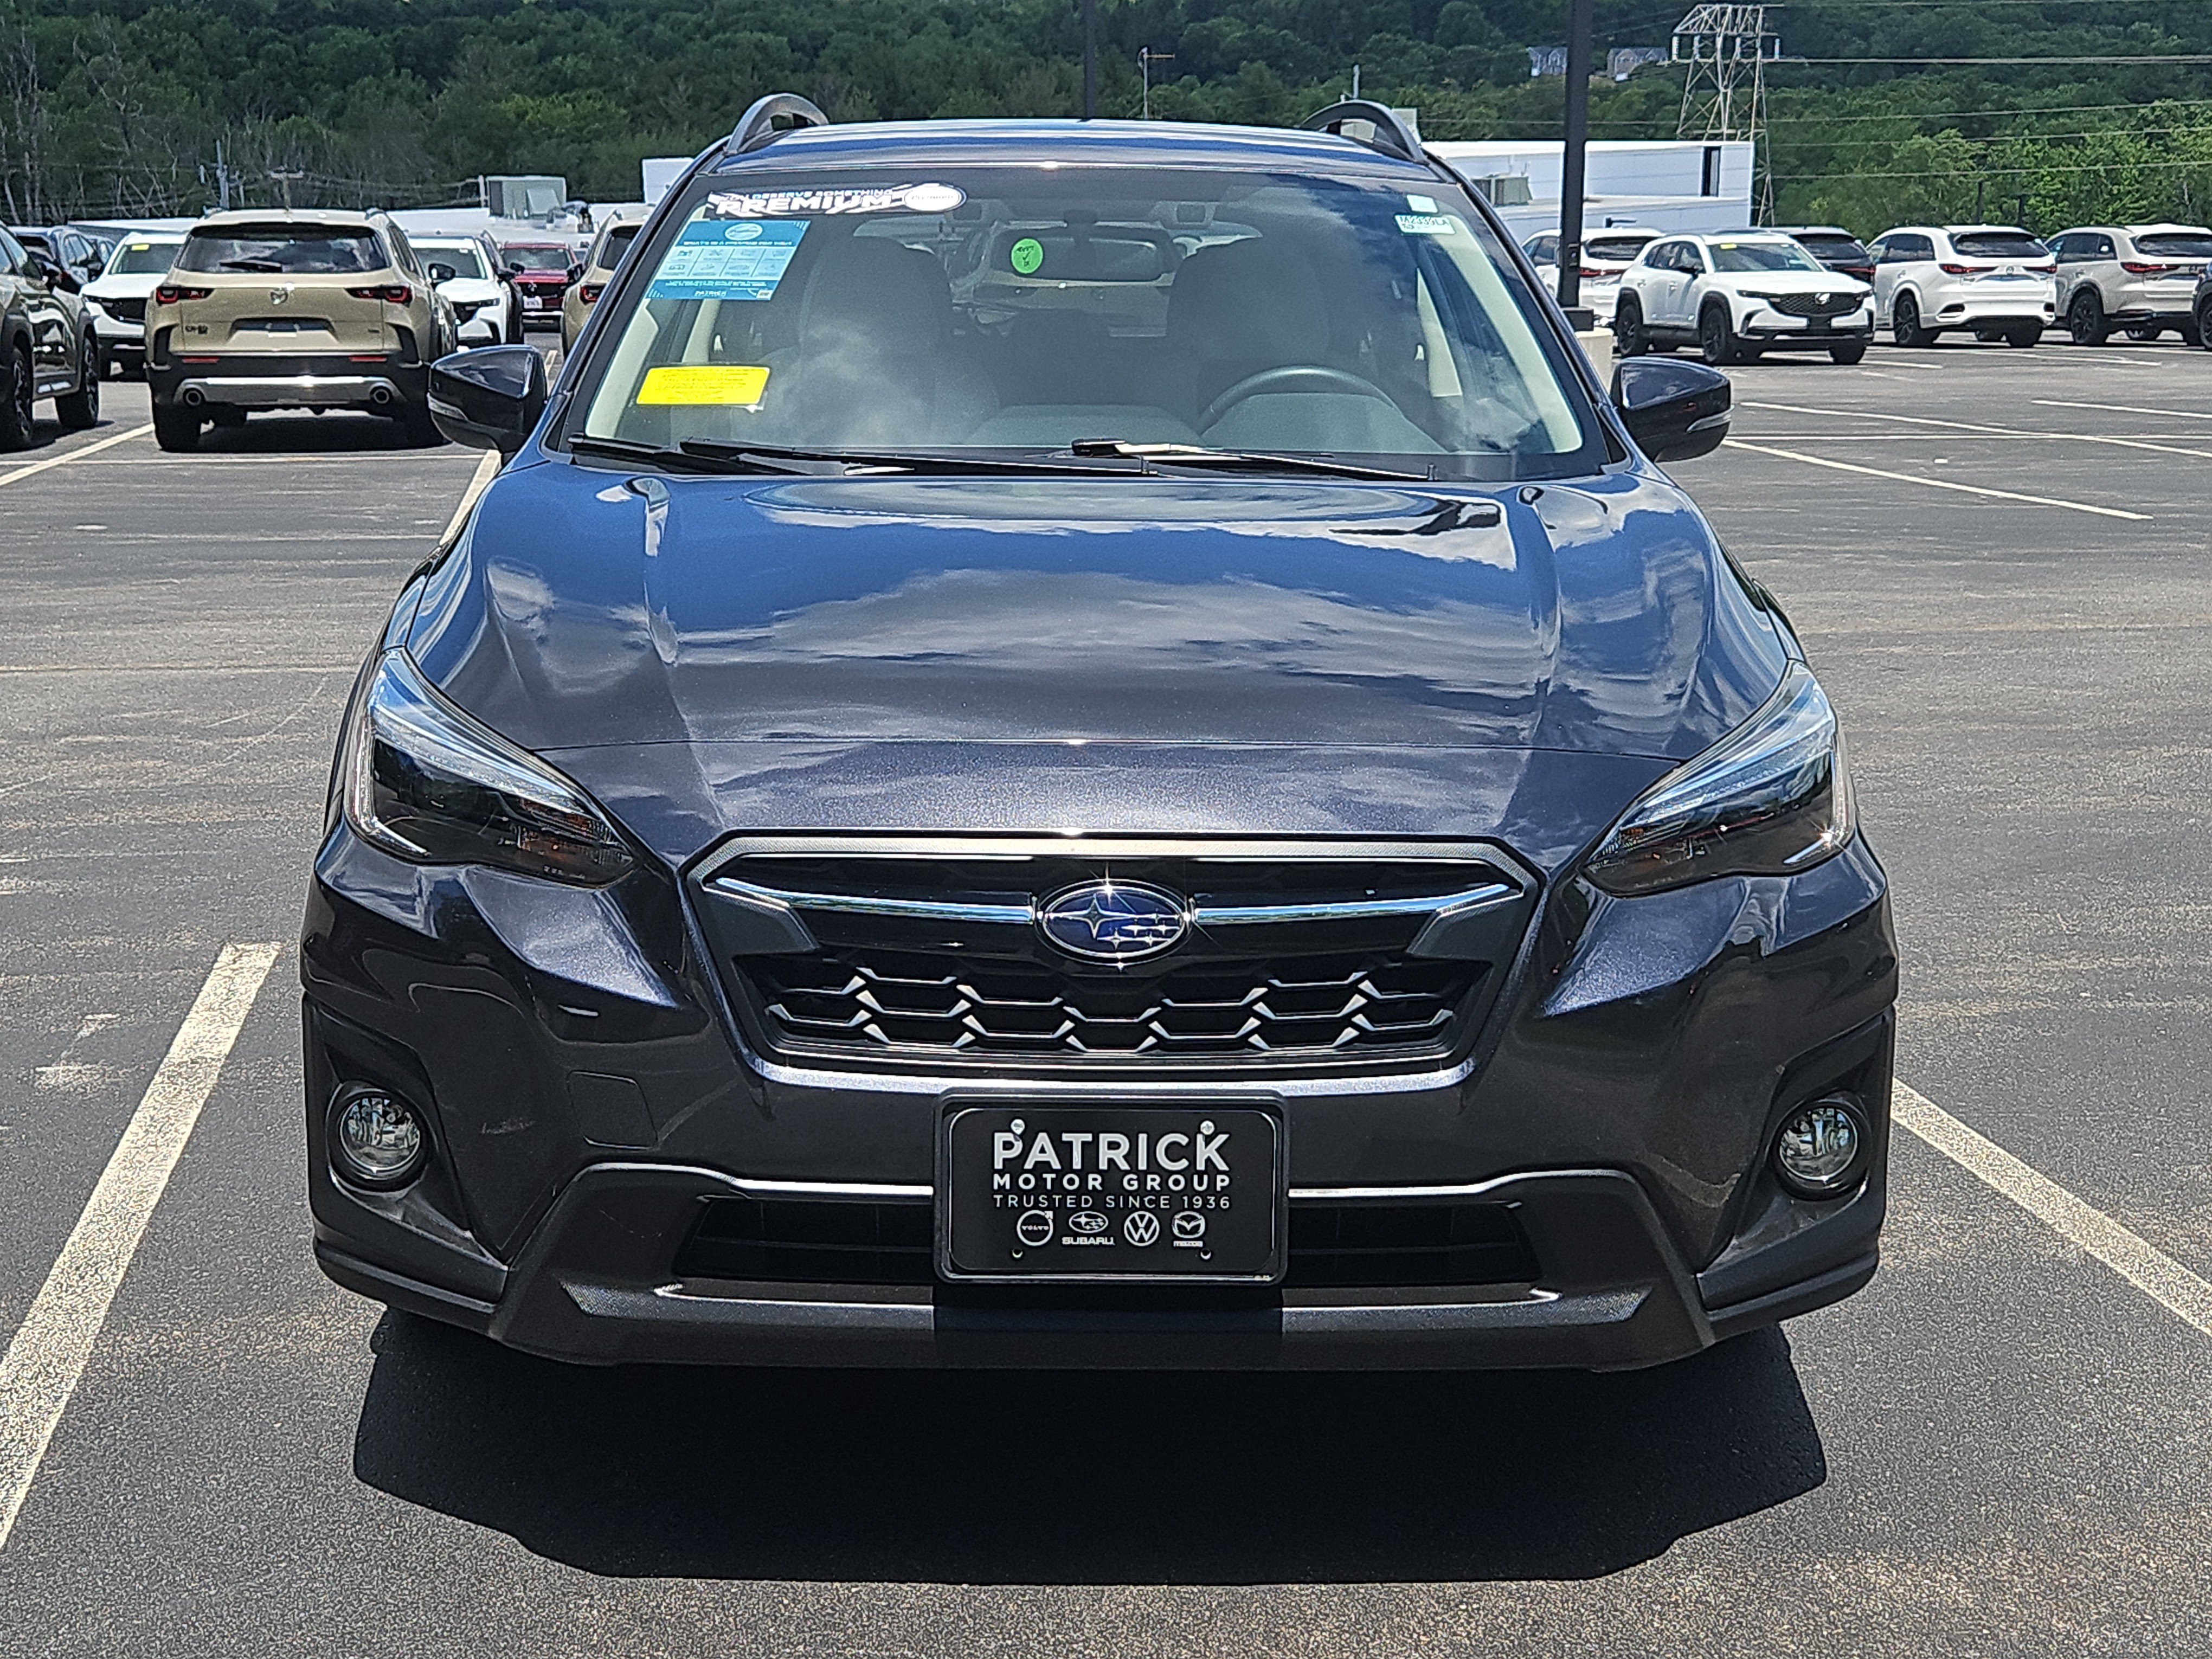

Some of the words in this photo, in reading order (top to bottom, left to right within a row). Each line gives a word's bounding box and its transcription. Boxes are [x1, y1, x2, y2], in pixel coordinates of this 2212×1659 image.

[751, 191, 813, 200] DESERVE
[716, 194, 892, 215] PREMIUM
[993, 1132, 1230, 1171] PATRICK
[993, 1173, 1103, 1191] MOTOR
[1123, 1173, 1231, 1191] GROUP
[993, 1194, 1094, 1208] TRUSTED
[1105, 1195, 1171, 1209] SINCE
[1182, 1195, 1231, 1210] 1936
[1062, 1236, 1114, 1245] SUBARU
